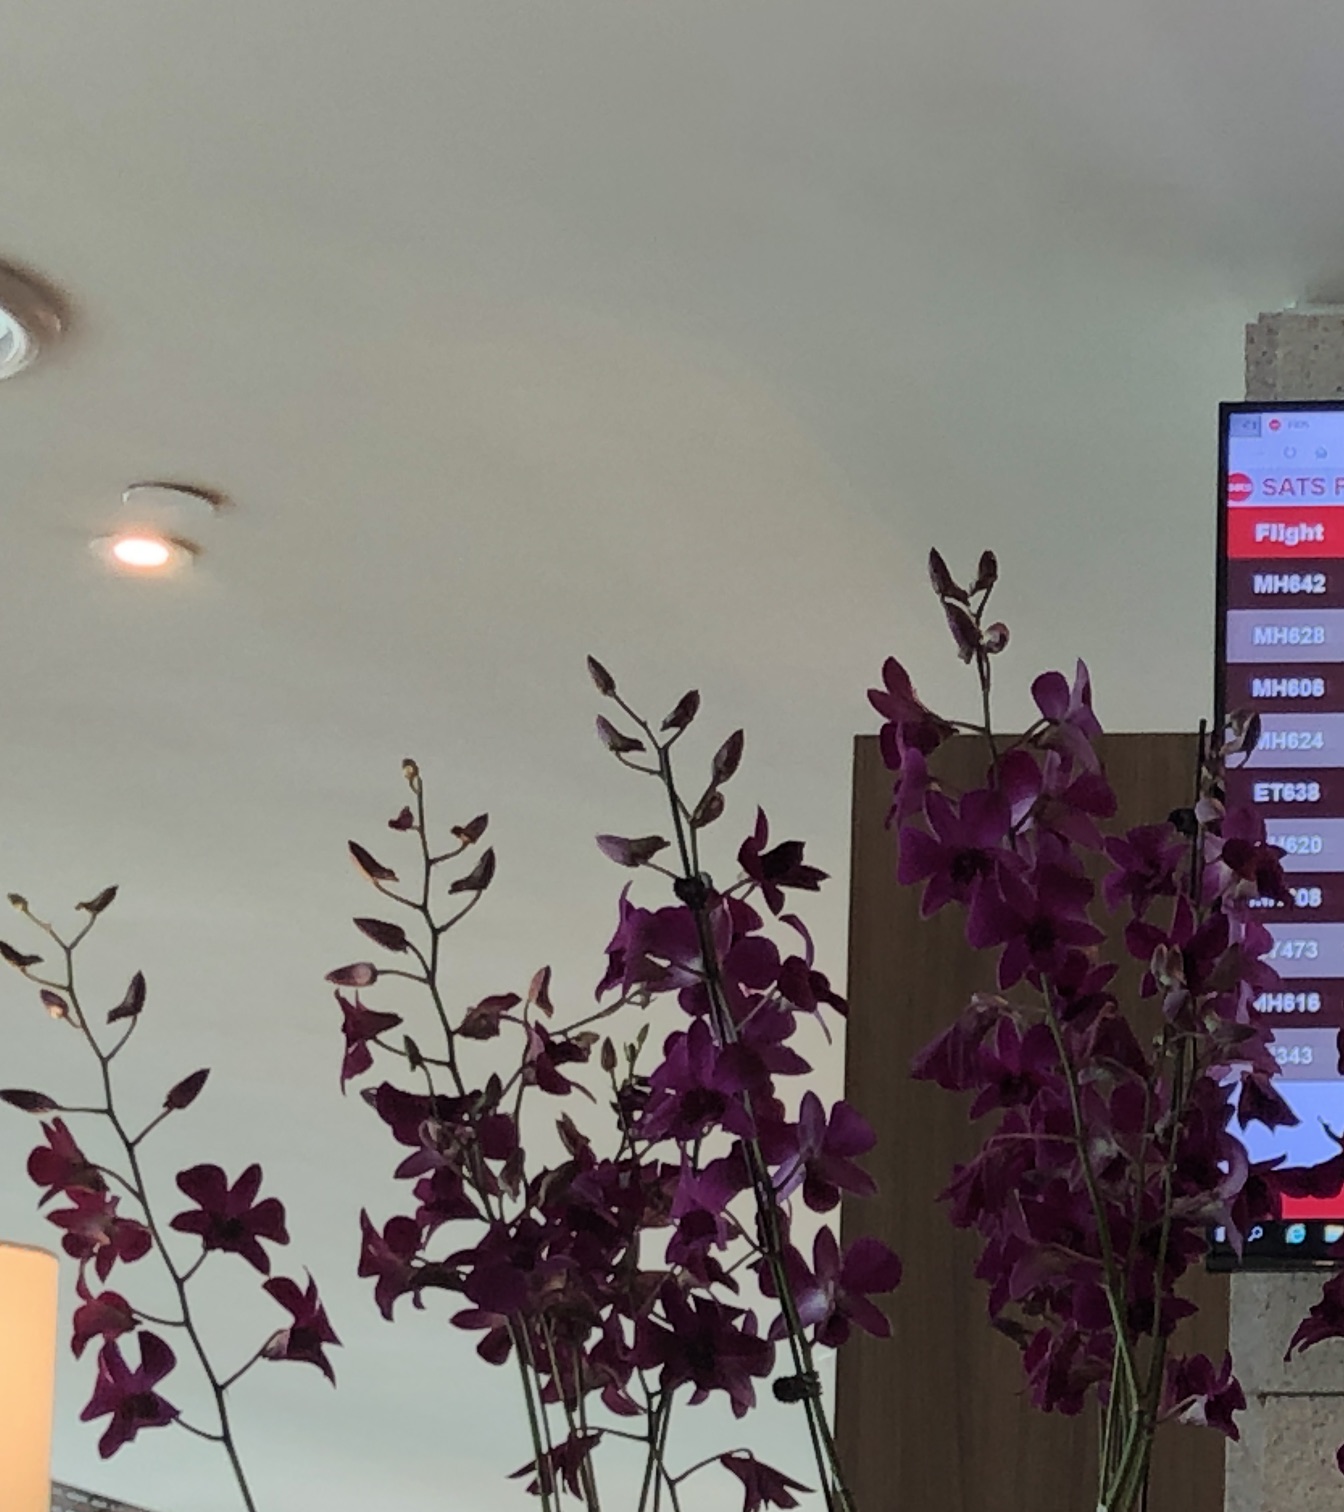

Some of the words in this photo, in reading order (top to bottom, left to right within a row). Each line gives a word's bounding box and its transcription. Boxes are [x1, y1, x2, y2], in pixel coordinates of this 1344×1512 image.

[1262, 477, 1325, 496] SATS
[1254, 522, 1325, 547] Flight
[1252, 573, 1327, 595] MH642
[1252, 625, 1326, 646] MH628
[1253, 781, 1321, 803] ET638
